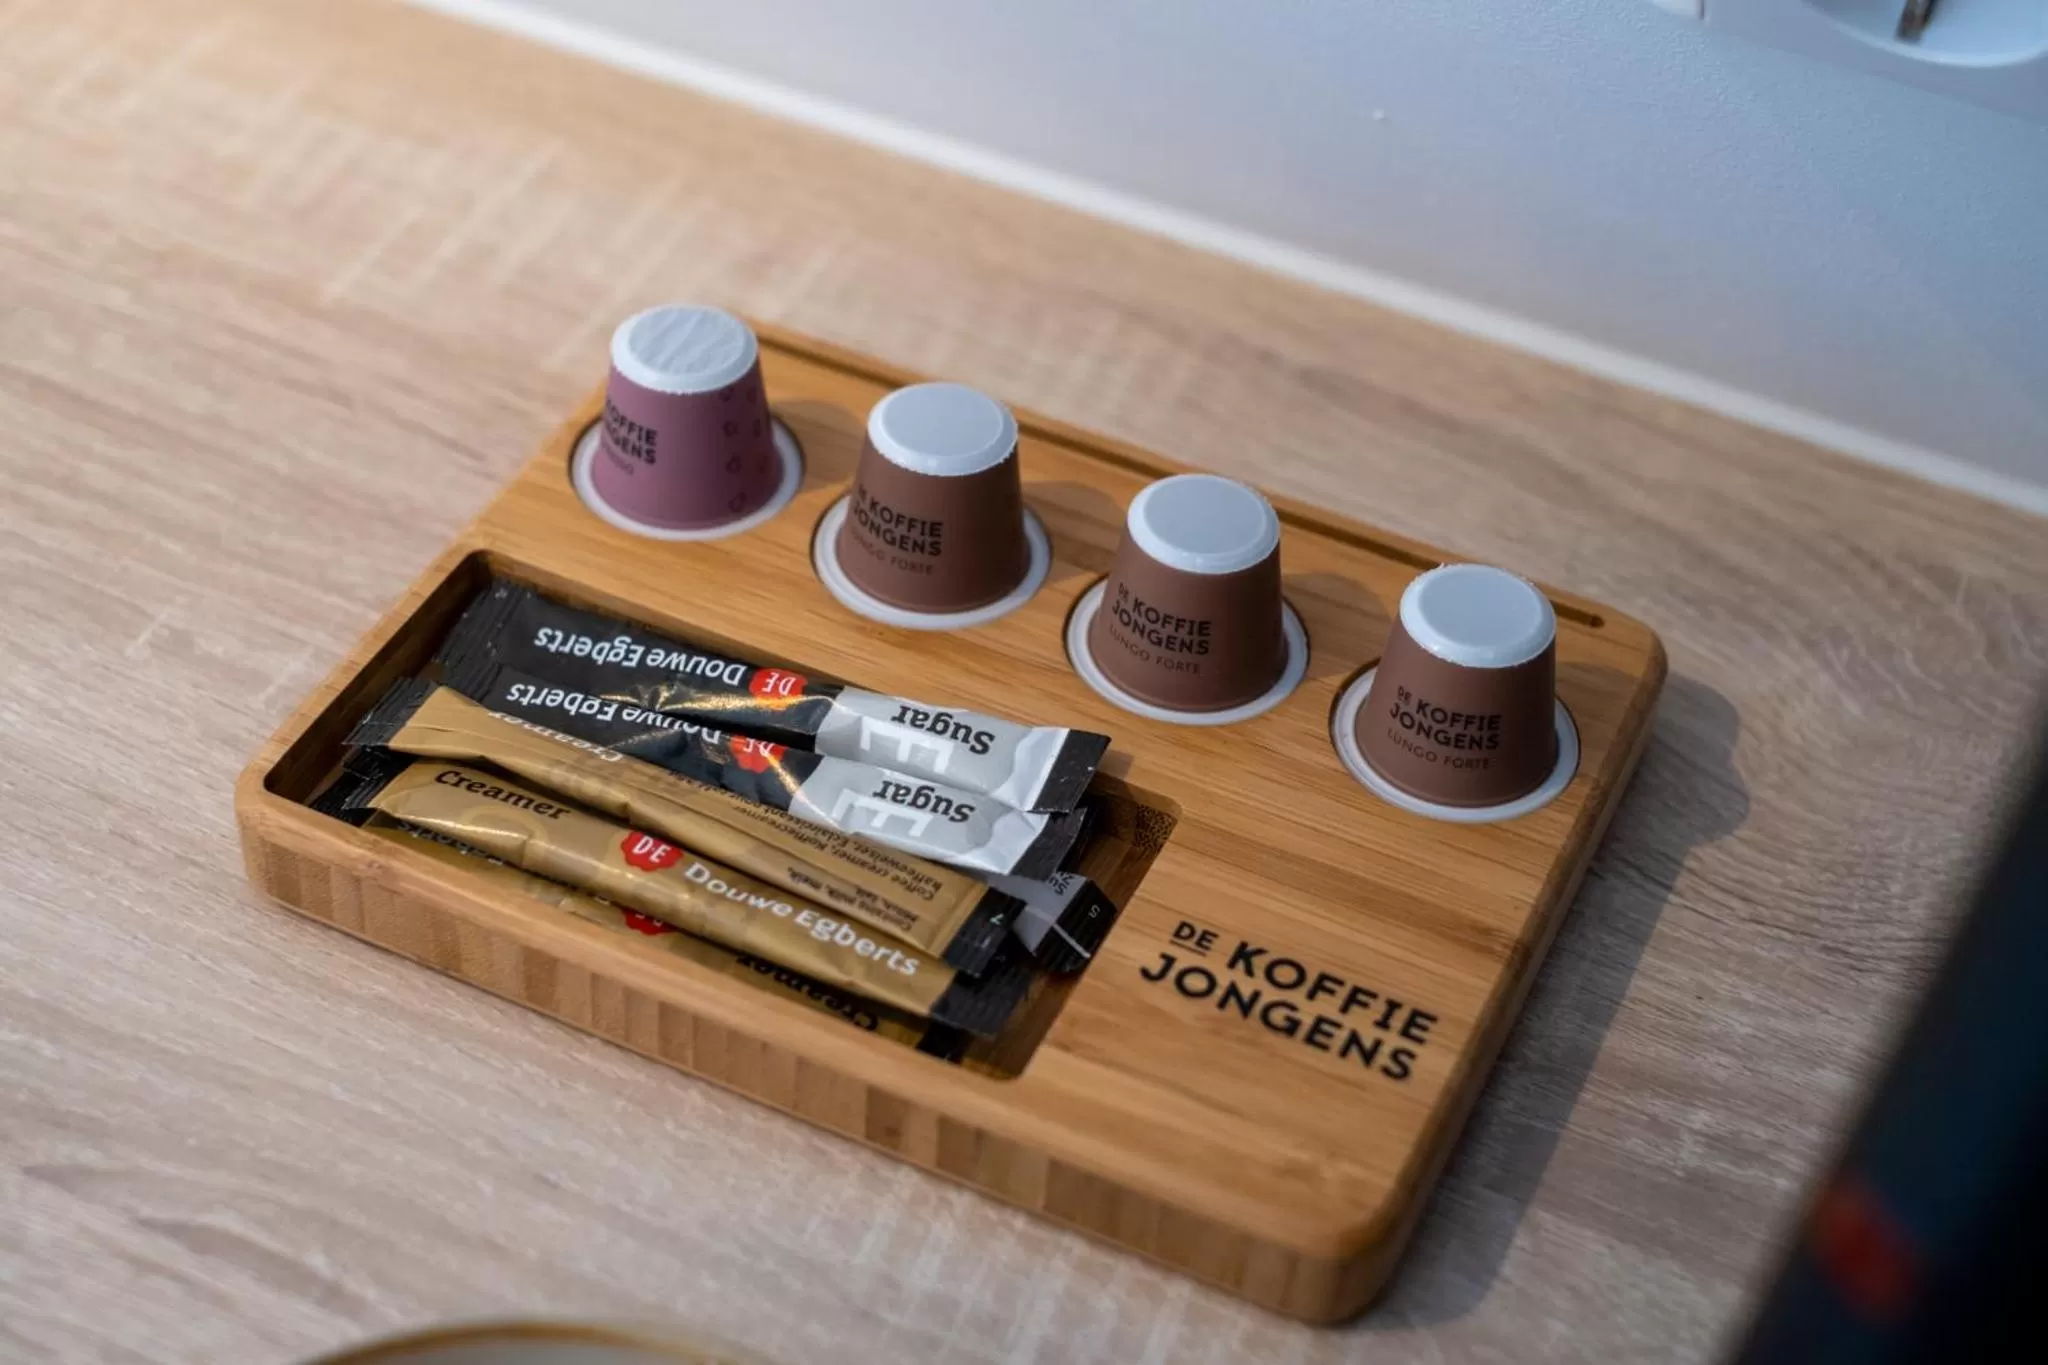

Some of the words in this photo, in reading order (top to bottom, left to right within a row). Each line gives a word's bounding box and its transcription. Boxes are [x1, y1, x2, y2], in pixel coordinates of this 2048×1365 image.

[854, 501, 943, 557] JONGENS
[869, 497, 944, 537] KOFFIE
[890, 556, 934, 575] FORTE
[1112, 599, 1210, 655] JONGENS
[1132, 597, 1213, 637] KOFFIE
[534, 626, 645, 668] Egberts
[646, 648, 747, 686] Douwe
[1109, 623, 1150, 661] LUNGO
[1156, 655, 1200, 674] FORTE
[506, 683, 619, 722] Egberts
[1415, 698, 1502, 732] KOFFIE
[891, 705, 995, 755] Sugar
[1387, 727, 1438, 763] LUNGO
[1444, 755, 1490, 770] FORTE
[1389, 702, 1500, 752] JONGENS
[434, 770, 572, 820] Creamer
[873, 779, 976, 823] Sugar
[891, 874, 934, 901] Coffee
[685, 861, 793, 917] Douwe
[795, 908, 920, 976] Egberts
[1169, 920, 1219, 956] DE
[1226, 940, 1438, 1045] KOFFIE
[1139, 952, 1417, 1081] JONGENS
